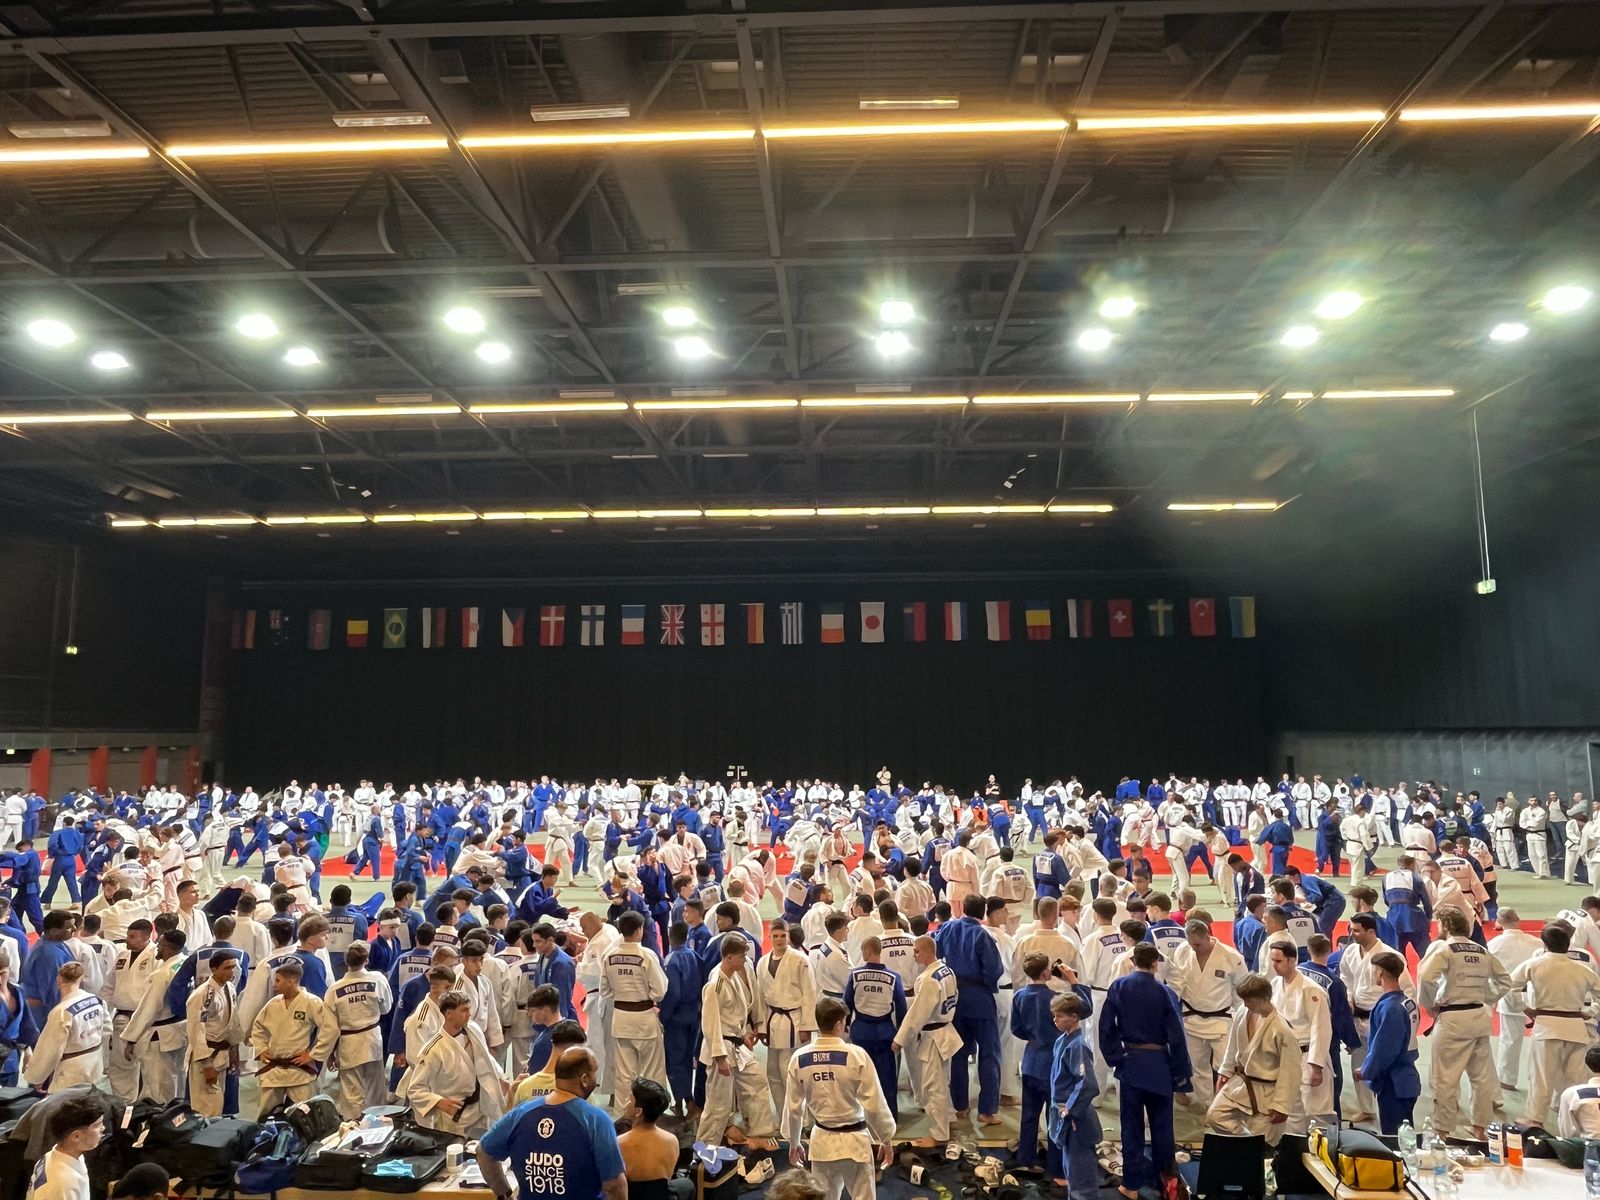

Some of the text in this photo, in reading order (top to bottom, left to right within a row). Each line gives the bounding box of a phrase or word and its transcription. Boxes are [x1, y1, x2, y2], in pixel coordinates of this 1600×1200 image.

[889, 949, 906, 958] BRA
[1464, 955, 1480, 964] GER
[408, 966, 424, 974] BRA
[863, 985, 884, 993] GBR
[348, 994, 367, 1004] NED
[812, 1071, 835, 1082] GER
[525, 1152, 564, 1167] JUDO
[525, 1165, 564, 1178] SINCE
[525, 1176, 566, 1195] 1918
